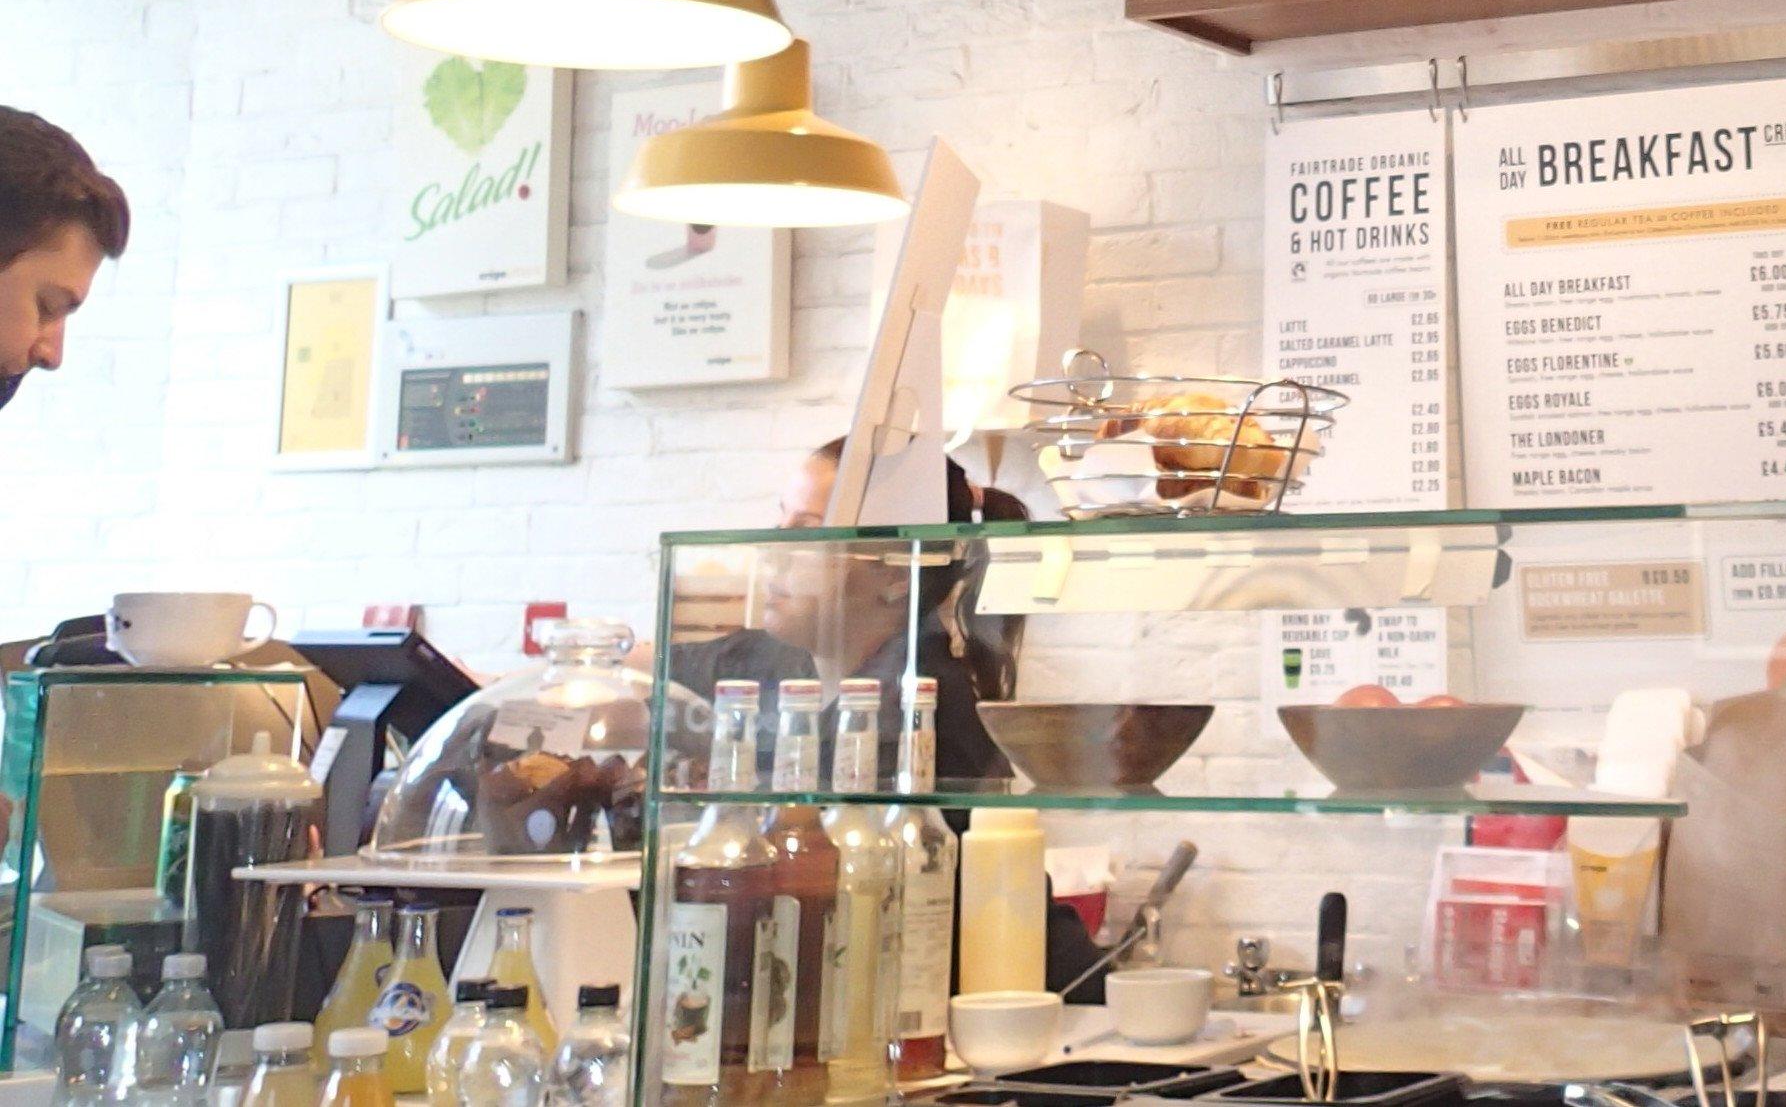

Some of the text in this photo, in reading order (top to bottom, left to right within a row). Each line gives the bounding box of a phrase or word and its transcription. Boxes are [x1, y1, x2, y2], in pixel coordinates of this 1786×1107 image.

[1291, 152, 1430, 176] FAIRTRADE ORGANIC
[1499, 147, 1526, 168] ALL
[1538, 125, 1757, 188] BREAKFAST
[404, 141, 542, 241] Salad!
[1500, 171, 1526, 191] DAY
[1291, 173, 1430, 224] COFFEE
[1577, 216, 1628, 229] REGULAR
[1631, 214, 1653, 226] TEA
[1671, 209, 1714, 223] COFFEE
[1719, 204, 1778, 218] INCLUDED
[1291, 223, 1430, 254] & HOT DRINKS
[1504, 275, 1631, 298] ALL DAY BREAKFAST
[1279, 321, 1308, 333] LATTE
[1505, 315, 1603, 336] EGGS BENEDICT
[1316, 336, 1360, 350] CARAMEL
[1364, 334, 1393, 347] LATTE
[1507, 353, 1619, 374] EGGS FLORENTINE
[1508, 391, 1591, 410] EGGS ROYALE
[1511, 429, 1605, 448] THE LONDONER
[1512, 467, 1601, 486] MAPLE BACON
[1732, 564, 1755, 578] ADD
